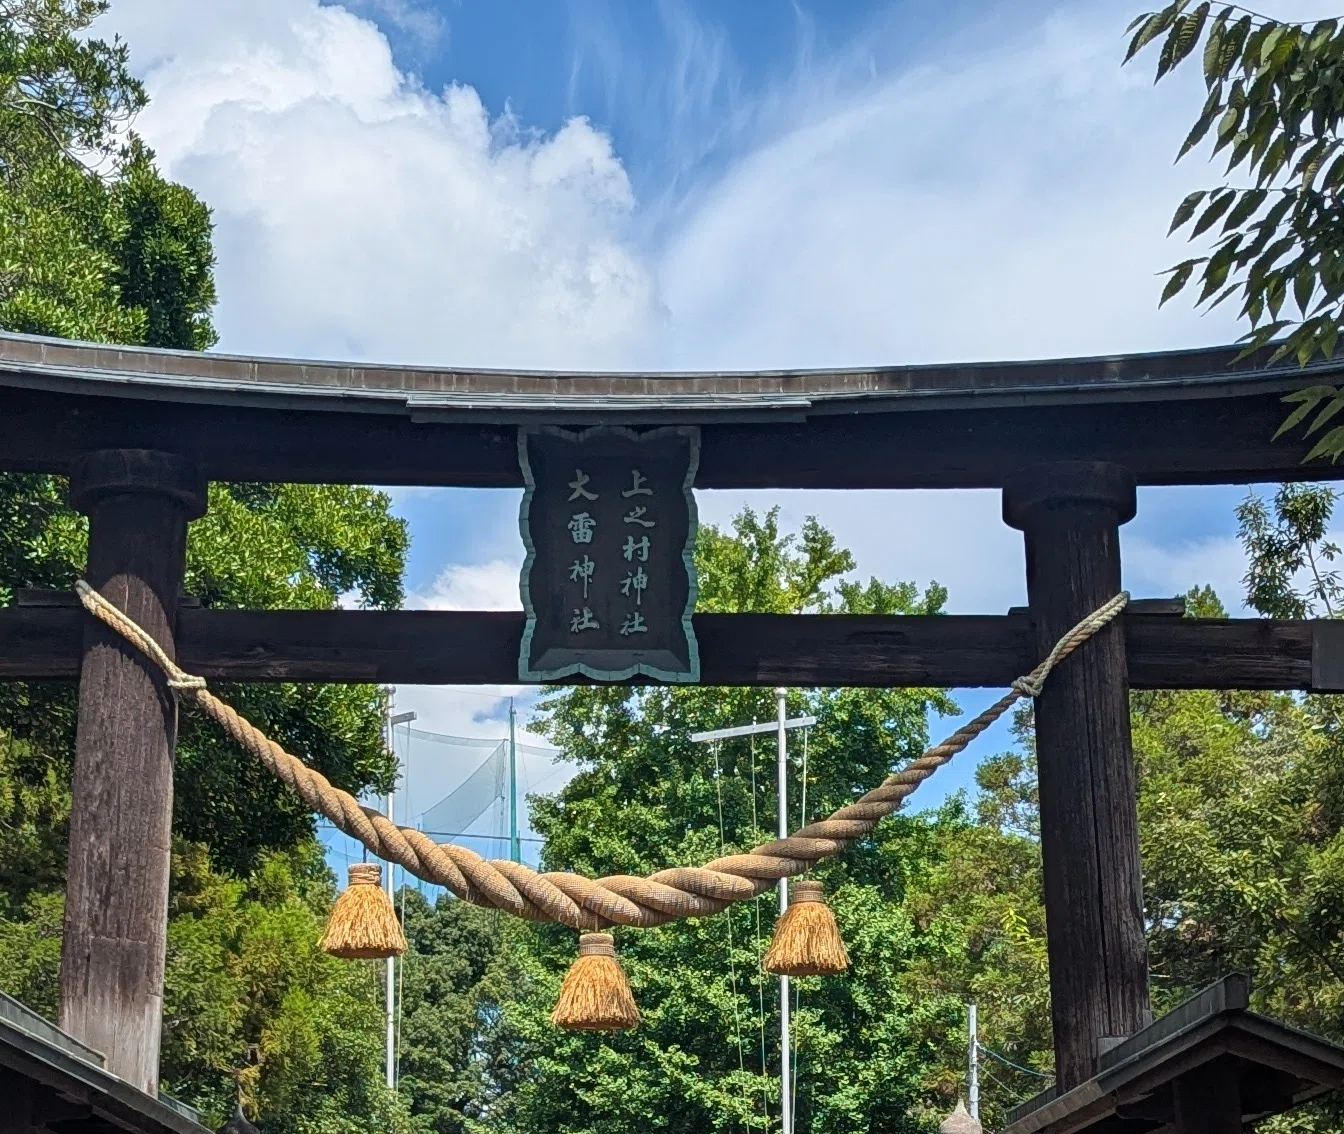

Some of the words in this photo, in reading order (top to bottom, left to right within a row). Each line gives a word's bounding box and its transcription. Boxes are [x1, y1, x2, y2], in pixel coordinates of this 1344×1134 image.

[567, 468, 600, 633] 大雷神社
[619, 469, 656, 636] 上之村神社
